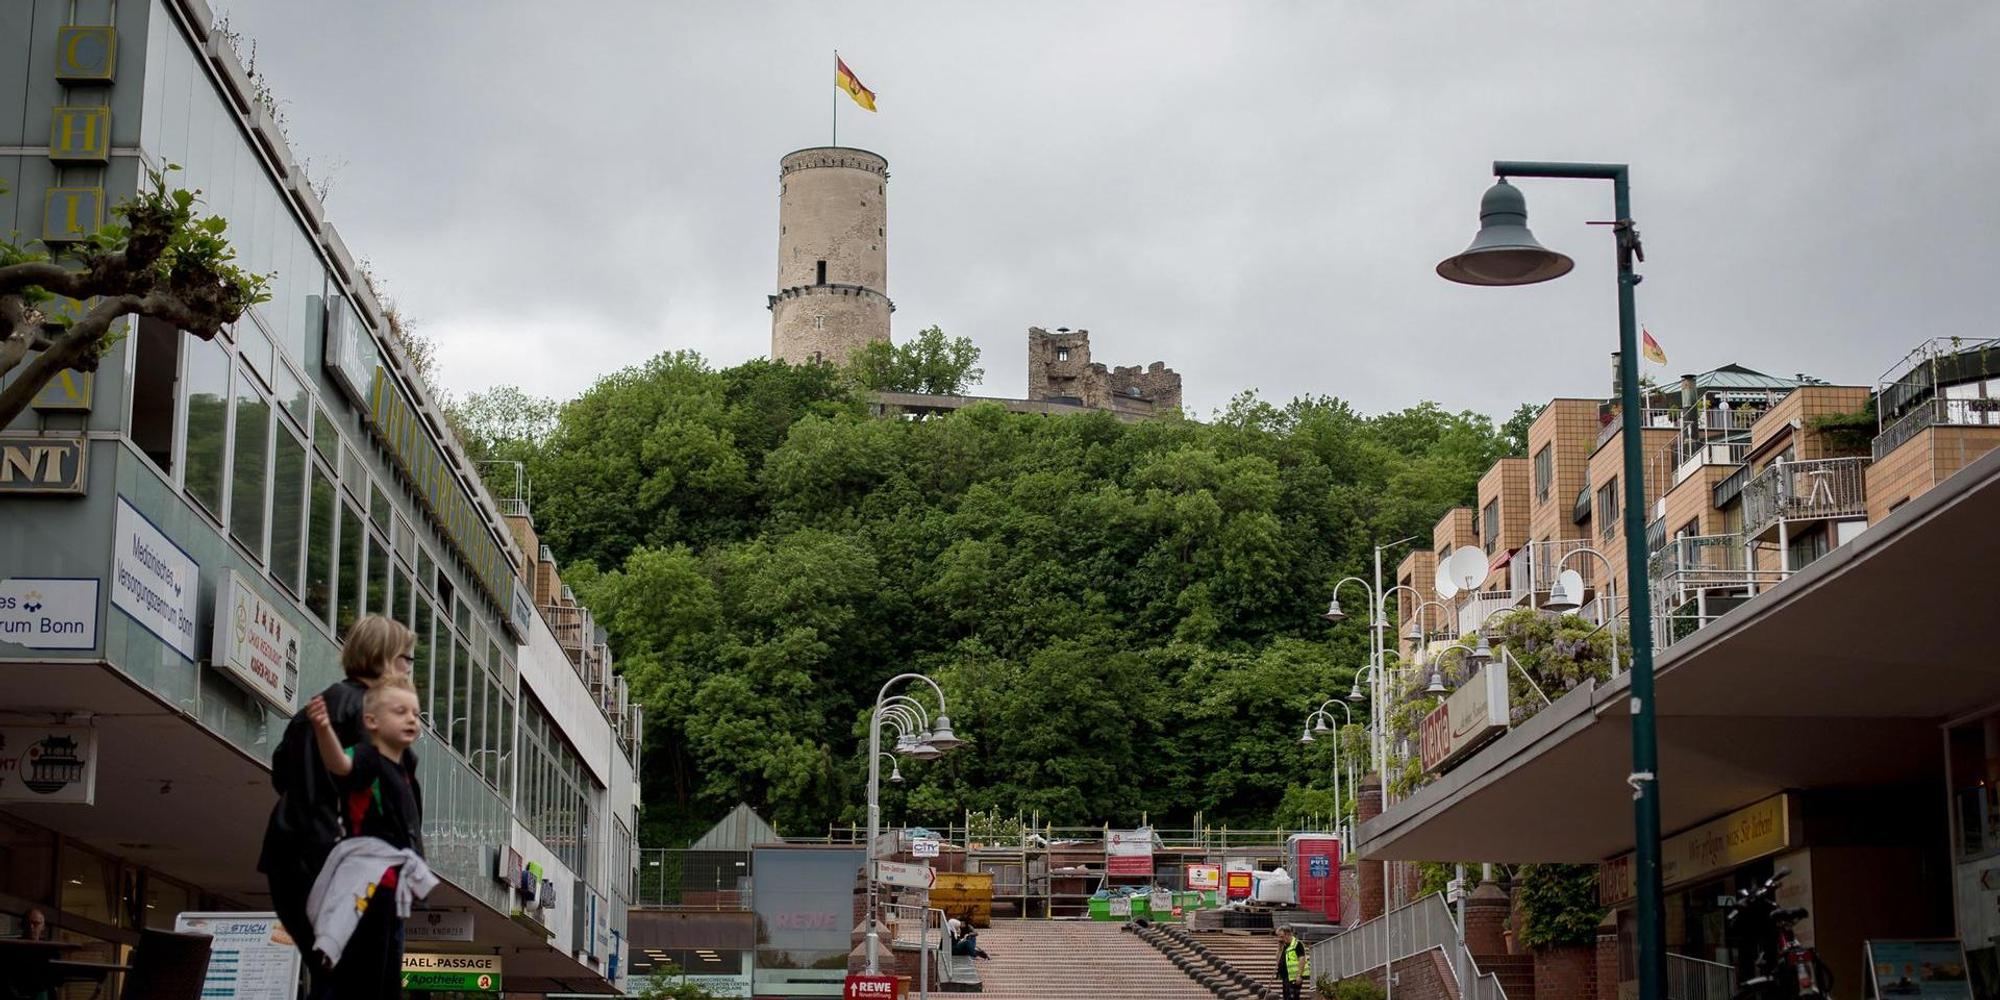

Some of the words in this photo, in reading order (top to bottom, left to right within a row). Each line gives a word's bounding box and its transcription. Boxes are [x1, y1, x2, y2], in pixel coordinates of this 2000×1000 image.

[1, 446, 70, 482] NT
[132, 533, 174, 588] Medizinisches
[118, 539, 177, 626] Versorgungszentrum
[177, 608, 193, 637] Bonn
[41, 617, 84, 634] Bonn
[776, 912, 836, 928] REWE
[411, 974, 465, 986] Apotheke
[859, 982, 892, 992] REWE
